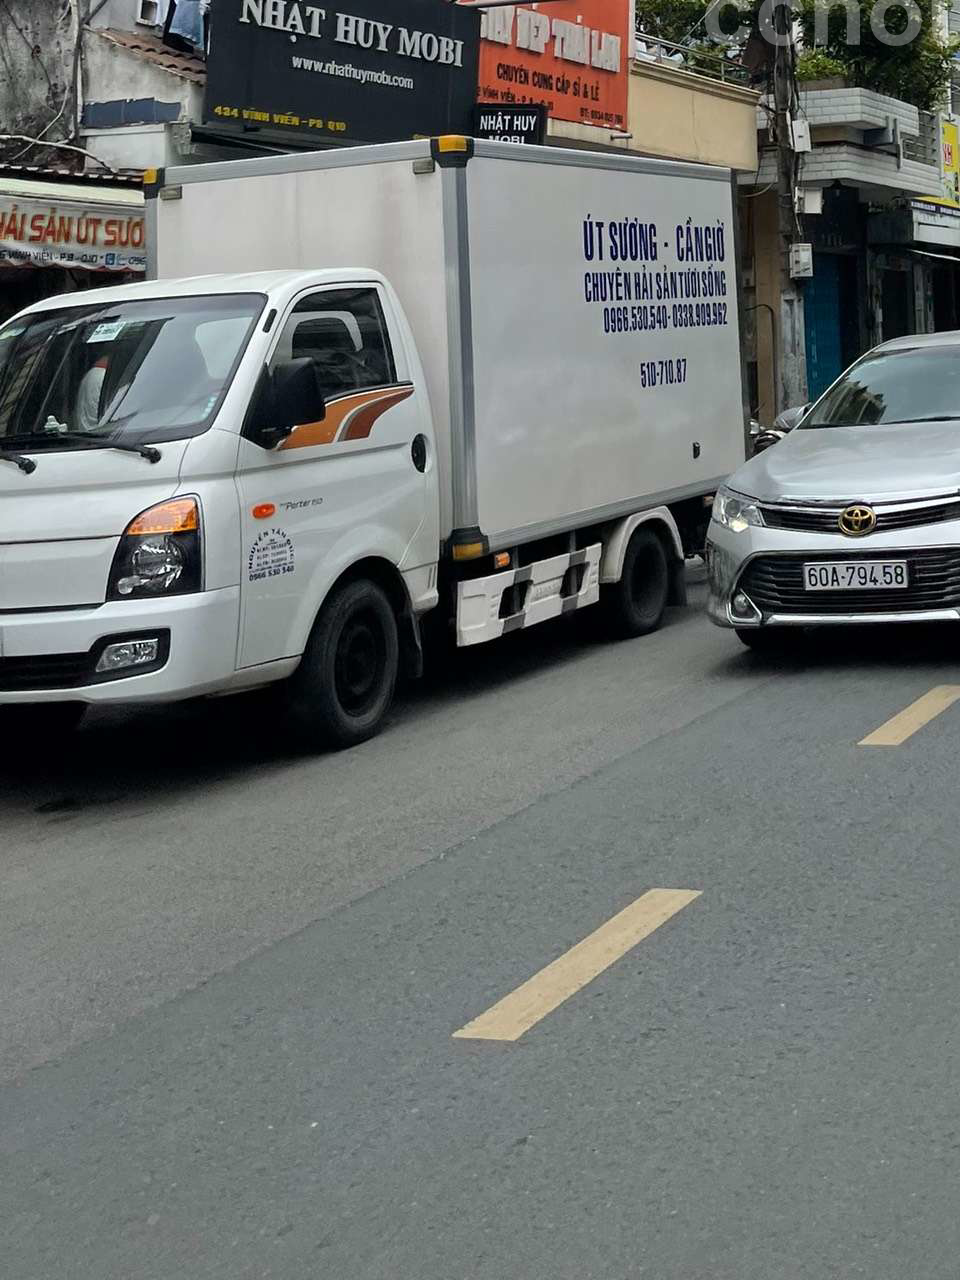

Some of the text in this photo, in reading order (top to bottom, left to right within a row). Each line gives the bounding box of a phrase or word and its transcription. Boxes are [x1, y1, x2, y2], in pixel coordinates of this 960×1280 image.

[334, 12, 394, 52] HUY
[397, 27, 465, 68] MOBI
[292, 55, 414, 90] www.nhathuymobi.com
[496, 63, 529, 87] CHUYÊN
[532, 72, 554, 92] CUNG
[582, 84, 589, 98] &
[480, 112, 537, 133] NHẬT HUY
[29, 207, 74, 244] SẢN
[76, 211, 102, 246] ÚT
[104, 216, 146, 248] SƯƠ
[583, 213, 604, 261] ÚT
[609, 217, 658, 261] SƯƠNG
[584, 264, 727, 303] CHUYÊN HẢI SẢN TƯƠI SỐNG
[640, 358, 687, 388] 51D-710.87
[808, 565, 905, 587] 60A-794.58
